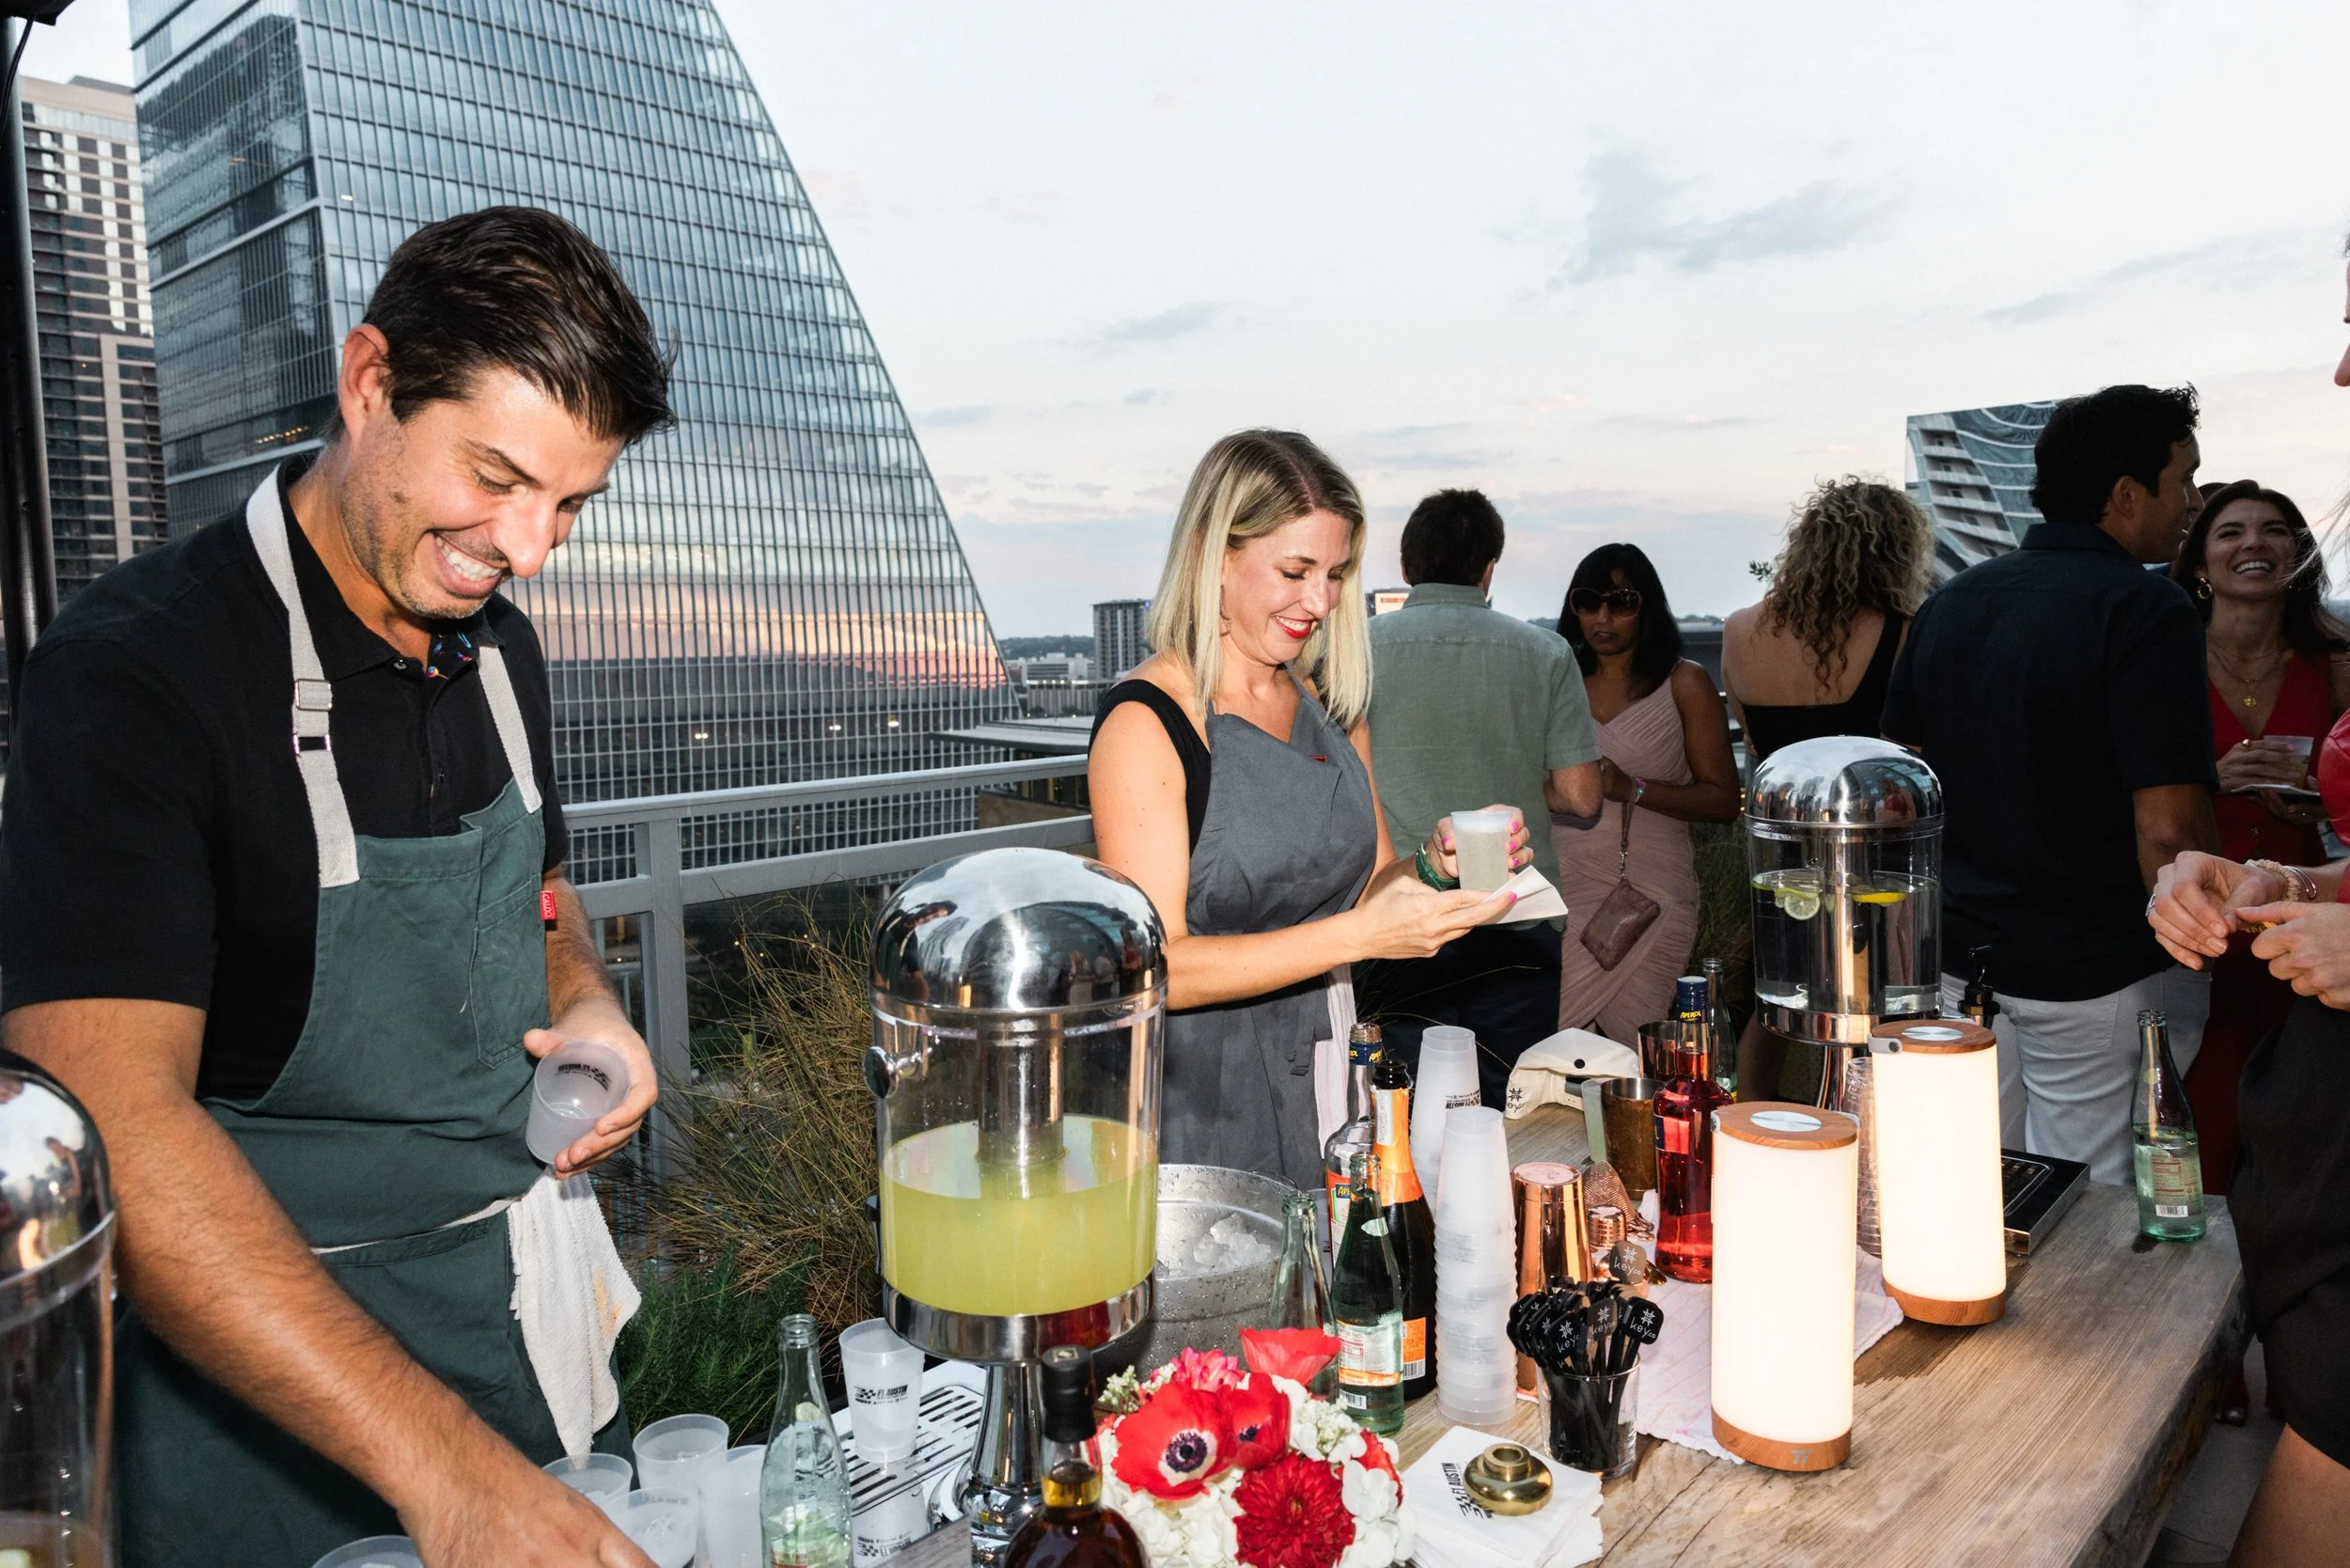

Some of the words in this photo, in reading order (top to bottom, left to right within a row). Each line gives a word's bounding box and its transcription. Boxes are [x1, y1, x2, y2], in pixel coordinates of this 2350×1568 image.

[1680, 1011, 1702, 1020] APEROL
[1338, 1184, 1351, 1197] APE
[885, 1384, 909, 1397] AUSTIN
[1441, 1462, 1464, 1487] AUSTIN
